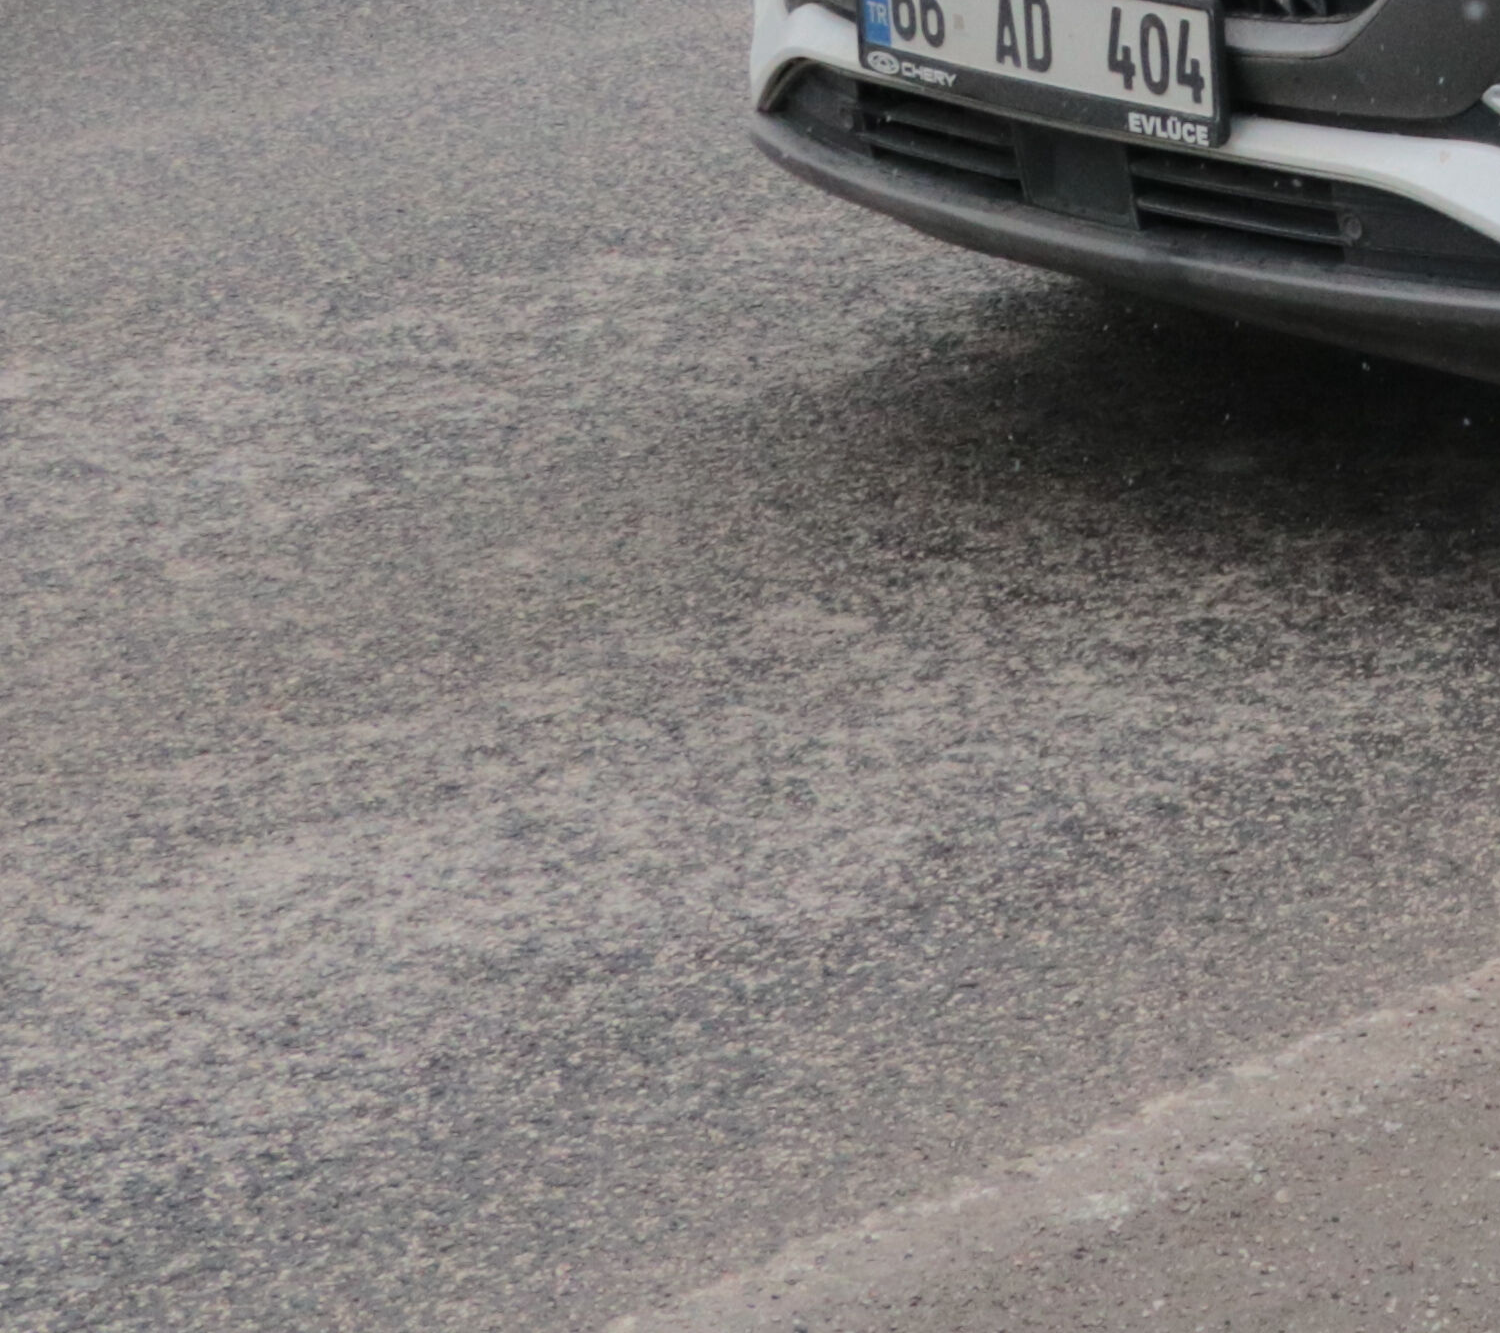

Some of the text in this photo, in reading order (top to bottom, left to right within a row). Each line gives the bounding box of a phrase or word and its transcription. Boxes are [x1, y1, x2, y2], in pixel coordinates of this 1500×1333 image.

[866, 0, 888, 26] TR
[1107, 6, 1205, 104] 404
[902, 62, 957, 88] CHERY
[1128, 112, 1209, 147] EVLÜCE
